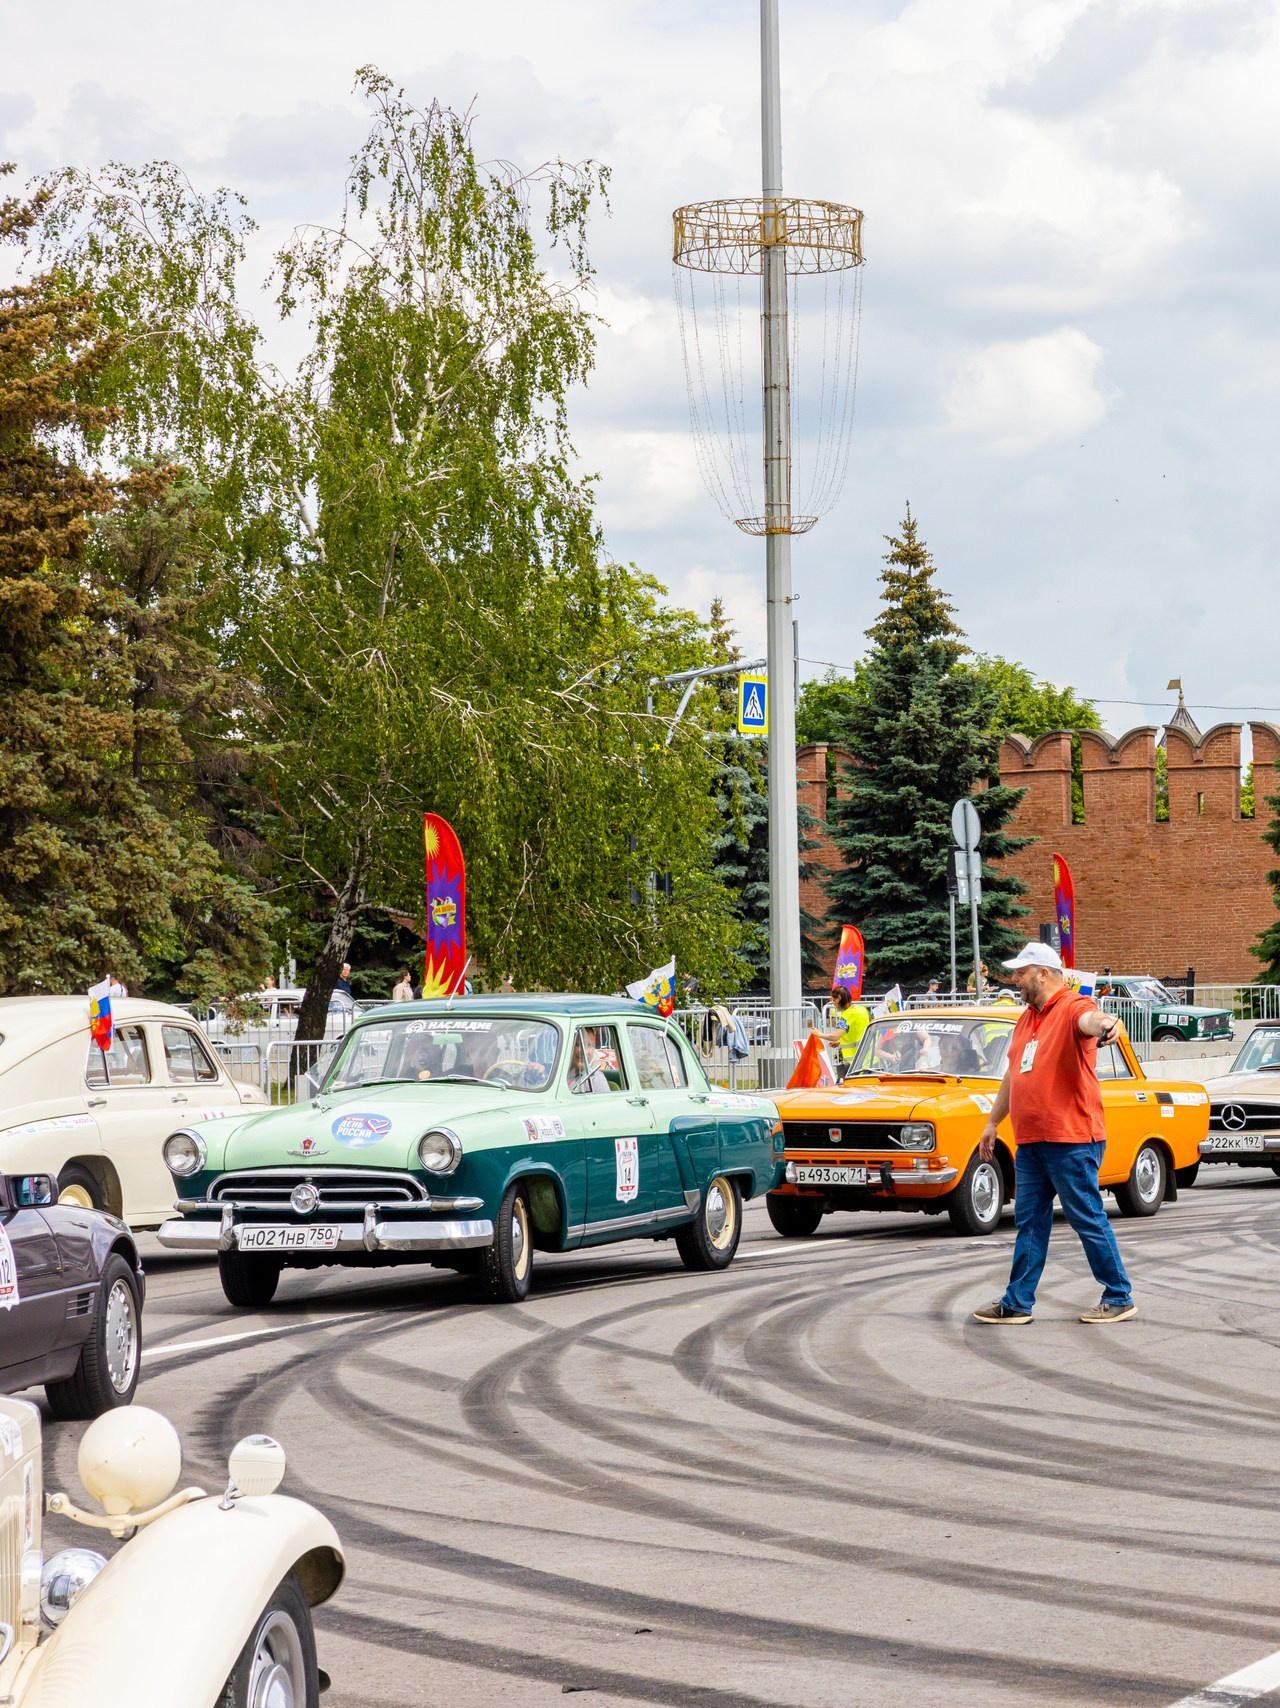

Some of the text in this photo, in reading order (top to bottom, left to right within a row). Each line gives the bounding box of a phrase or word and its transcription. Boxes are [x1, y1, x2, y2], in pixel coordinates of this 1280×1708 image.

[427, 1021, 493, 1031] НАСЛЕДИЕ
[913, 1023, 964, 1033] НАСЛЕДИЕ
[340, 1120, 363, 1128] ДЕНЬ
[337, 1127, 371, 1137] РОССИИ
[1206, 1136, 1259, 1149] 222КК 197
[624, 1167, 631, 1185] 14
[799, 1168, 862, 1183] В493ОК 71
[245, 1228, 333, 1246] Н021НВ 750
